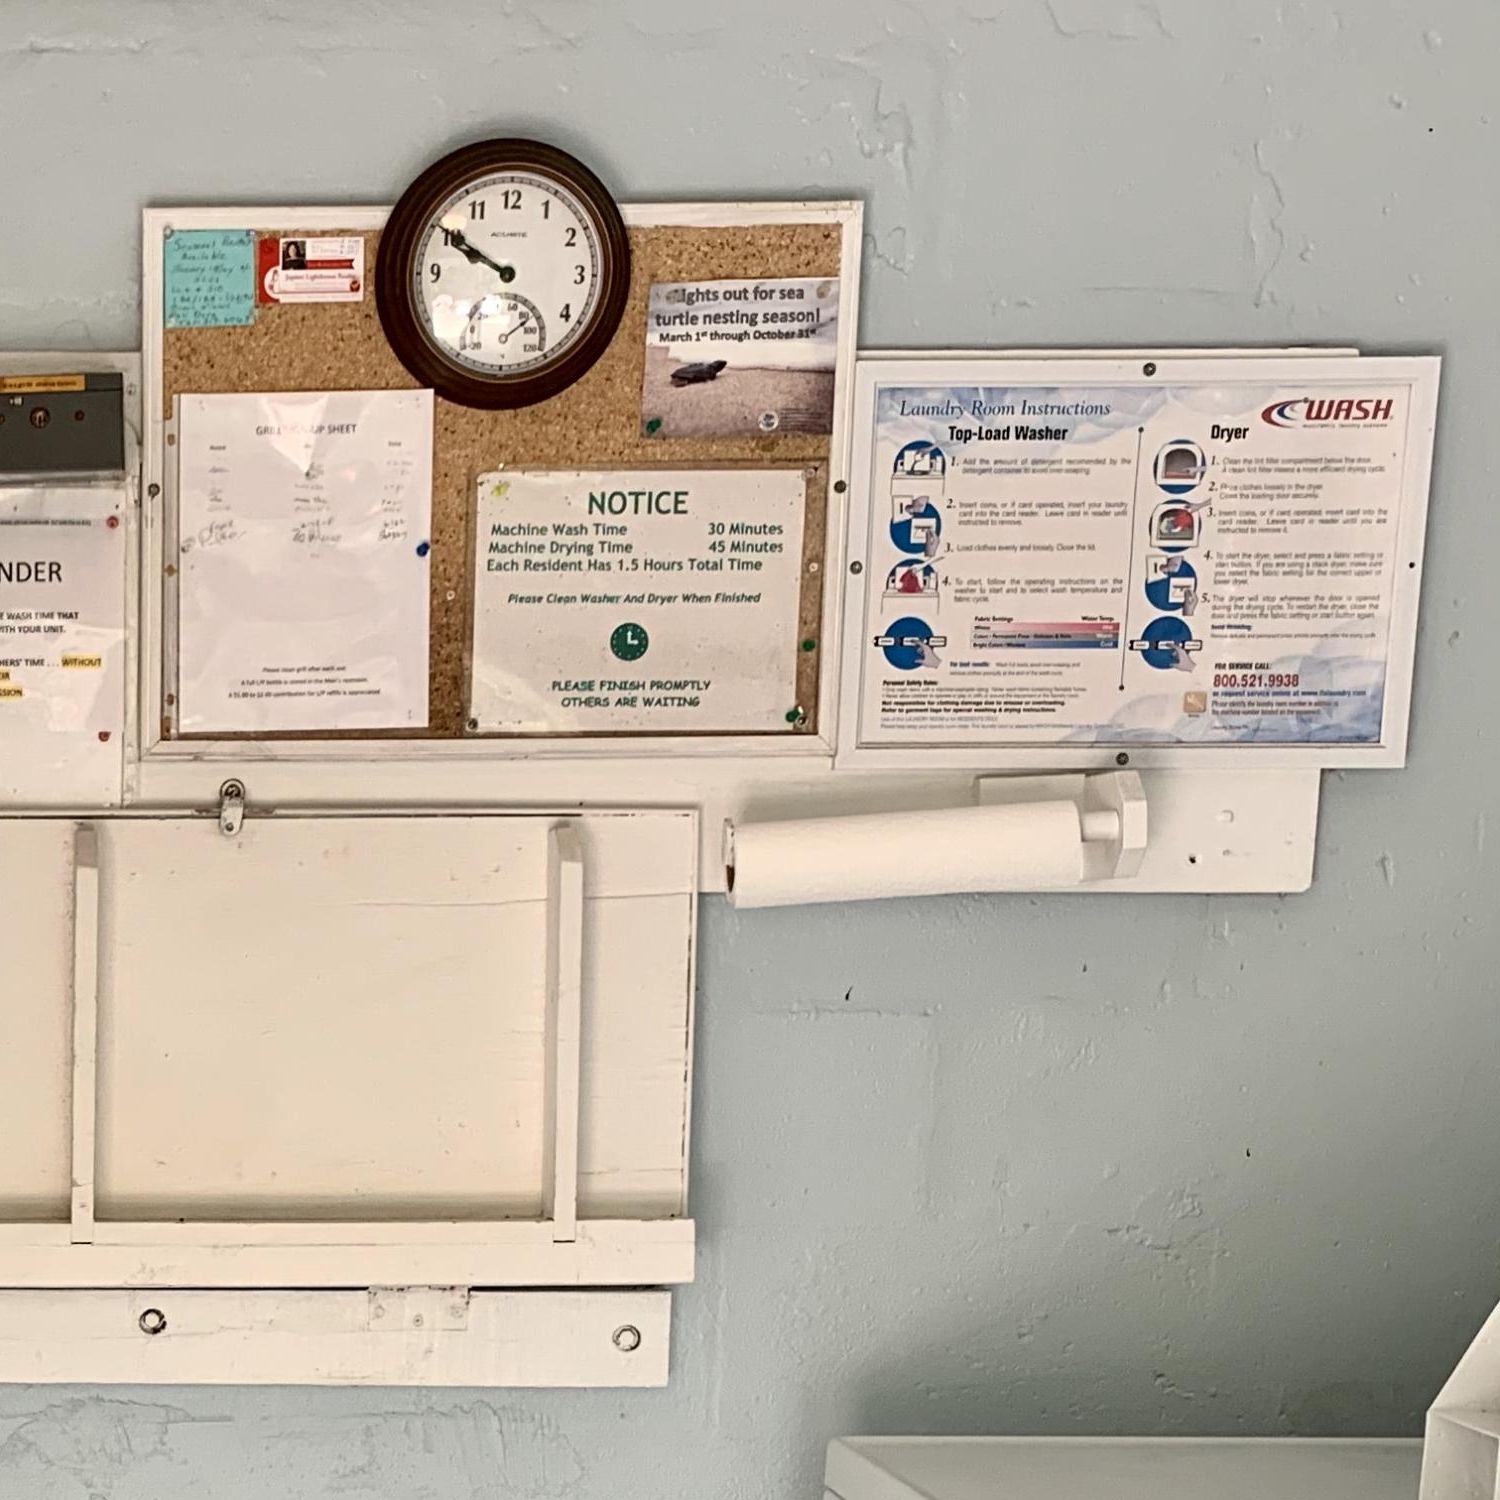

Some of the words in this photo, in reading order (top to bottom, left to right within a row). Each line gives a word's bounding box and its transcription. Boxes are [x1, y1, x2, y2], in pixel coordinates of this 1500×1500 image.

[502, 190, 521, 209] 12
[469, 201, 485, 219] 11
[542, 200, 549, 219] 1
[565, 228, 576, 247] 2
[431, 264, 441, 283] 9
[574, 265, 585, 284] 3
[676, 288, 718, 305] ights
[723, 290, 748, 300] out
[753, 286, 775, 300] for
[779, 288, 804, 299] sea
[560, 304, 571, 322] 4
[655, 311, 698, 326] turtle
[703, 310, 758, 326] nesting
[762, 308, 820, 323] season!
[660, 332, 692, 342] March
[695, 331, 707, 341] 1st
[710, 330, 750, 342] through
[753, 330, 795, 340] October
[900, 400, 964, 419] Laundry
[972, 400, 1015, 416] Room
[1021, 400, 1111, 416] Instructions
[1306, 399, 1393, 420] WASH
[328, 424, 356, 435] SHEET
[948, 426, 1010, 444] Top-Load
[1015, 426, 1068, 440] Washer
[1211, 425, 1249, 443] Dryer
[588, 491, 689, 515] NOTICE
[491, 524, 548, 536] Machine
[552, 524, 588, 535] Wash
[593, 523, 627, 535] Time
[708, 522, 725, 535] 30
[729, 523, 783, 535] Minutes
[489, 541, 545, 554] Machine
[550, 541, 594, 556] Drying
[599, 541, 633, 553] Time
[709, 540, 725, 553] 45
[730, 541, 783, 553] Minutes
[487, 559, 519, 571] Each
[524, 559, 583, 571] Resident
[588, 559, 611, 571] Has
[618, 558, 638, 571] 1.5
[644, 559, 683, 571] Hours
[688, 558, 723, 571] Total
[728, 558, 762, 571] Time
[508, 594, 543, 603] Please
[546, 593, 577, 604] Clean
[581, 594, 621, 603] Washer
[623, 594, 645, 603] And
[647, 593, 678, 605] Dryer
[682, 593, 711, 603] When
[715, 593, 761, 603] Finished
[6, 612, 32, 620] WASH
[35, 611, 55, 619] TIME
[18, 625, 41, 634] YOUR
[62, 657, 101, 667] WITHOUT
[552, 680, 595, 691] PLEASE
[600, 680, 645, 691] FINISH
[650, 680, 711, 691] PROMPTLY
[1214, 674, 1298, 687] 800.521.9938
[561, 696, 610, 708] OTHERS
[615, 696, 637, 707] ARE
[643, 696, 700, 707] WAITING
